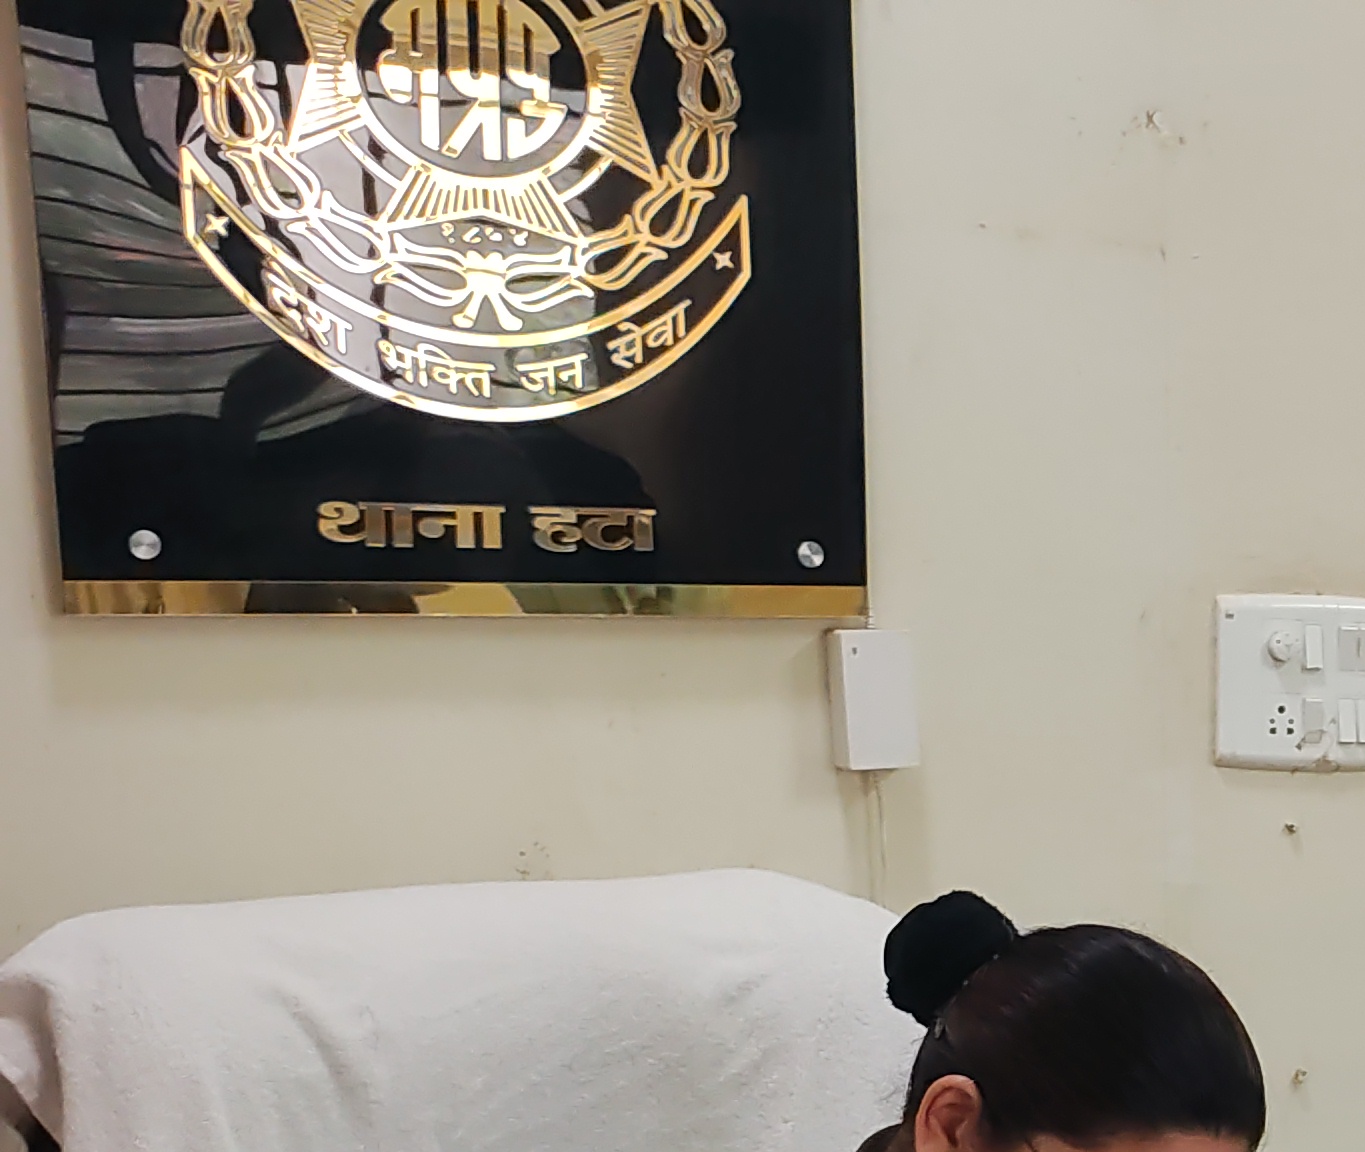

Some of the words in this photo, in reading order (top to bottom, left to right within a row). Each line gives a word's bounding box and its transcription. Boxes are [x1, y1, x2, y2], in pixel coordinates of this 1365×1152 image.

[376, 339, 496, 398] भक्ति
[515, 352, 589, 395] जन
[606, 299, 692, 368] सेवा
[317, 500, 506, 549] थाना
[527, 504, 657, 553] हटा
